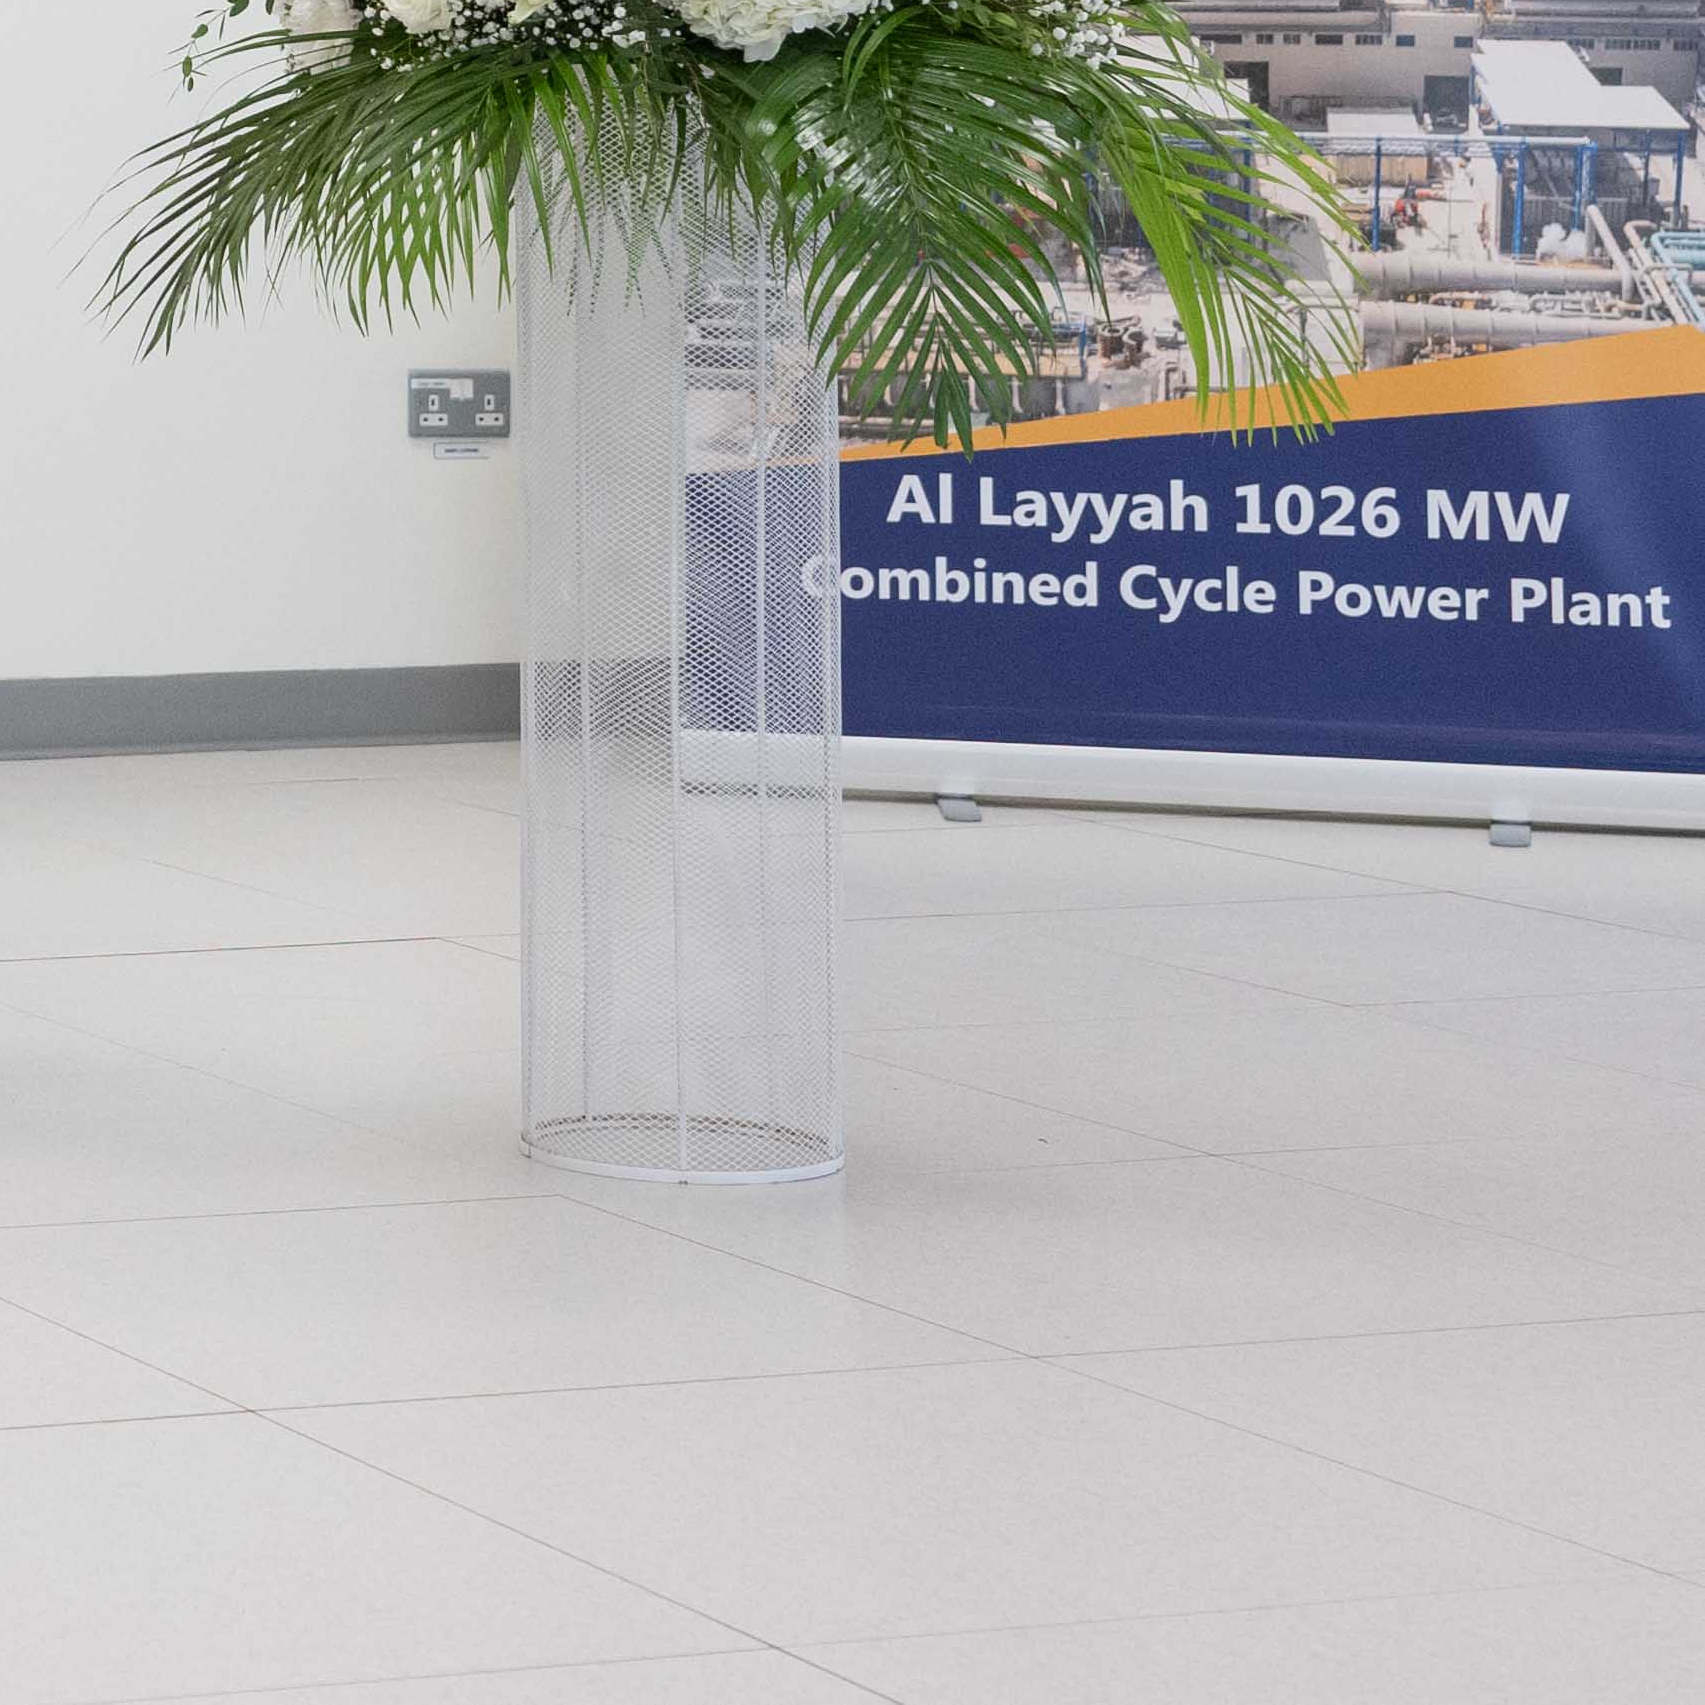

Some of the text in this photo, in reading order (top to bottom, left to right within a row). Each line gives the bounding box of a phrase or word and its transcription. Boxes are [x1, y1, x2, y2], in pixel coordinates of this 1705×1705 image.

[886, 472, 1571, 544] Al Layyah 1026 MW
[1119, 564, 1277, 624] Cycle
[1298, 570, 1489, 621] Power
[1510, 577, 1672, 629] Plant
